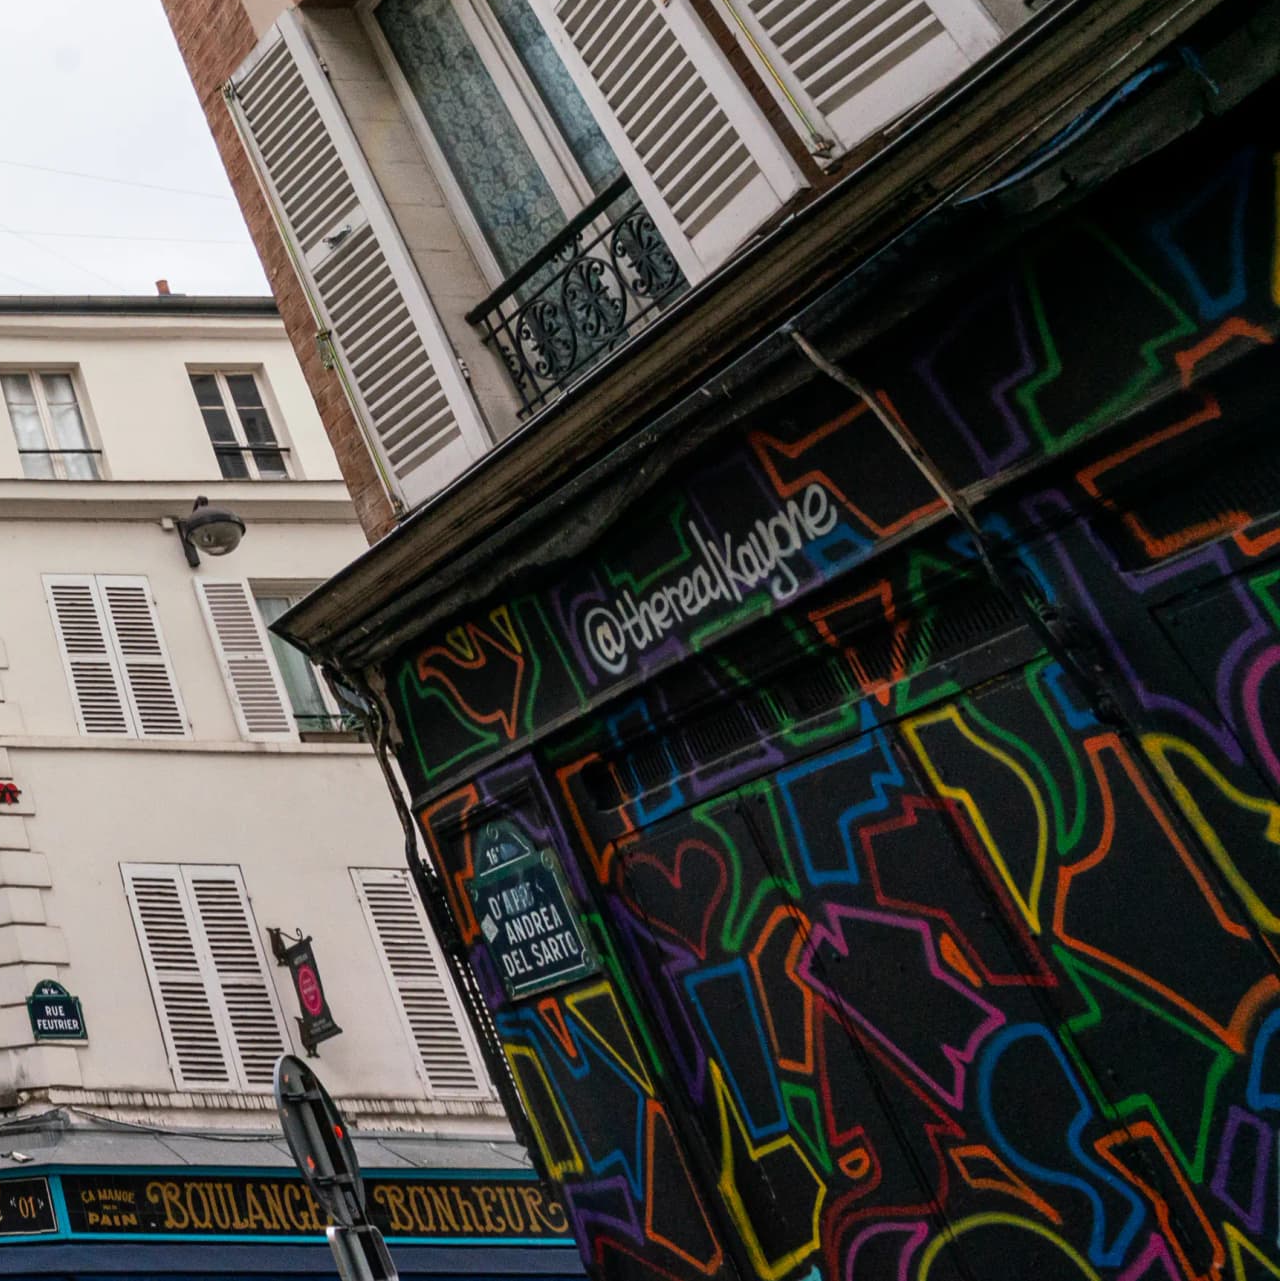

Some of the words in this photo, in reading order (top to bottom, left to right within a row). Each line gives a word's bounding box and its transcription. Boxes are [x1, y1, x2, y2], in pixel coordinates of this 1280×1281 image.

[501, 948, 534, 978] DEL
[45, 1005, 65, 1017] RUE
[37, 1019, 80, 1031] FEUTRIER
[146, 1181, 335, 1231] BOULANGE
[88, 1212, 138, 1227] PAIN
